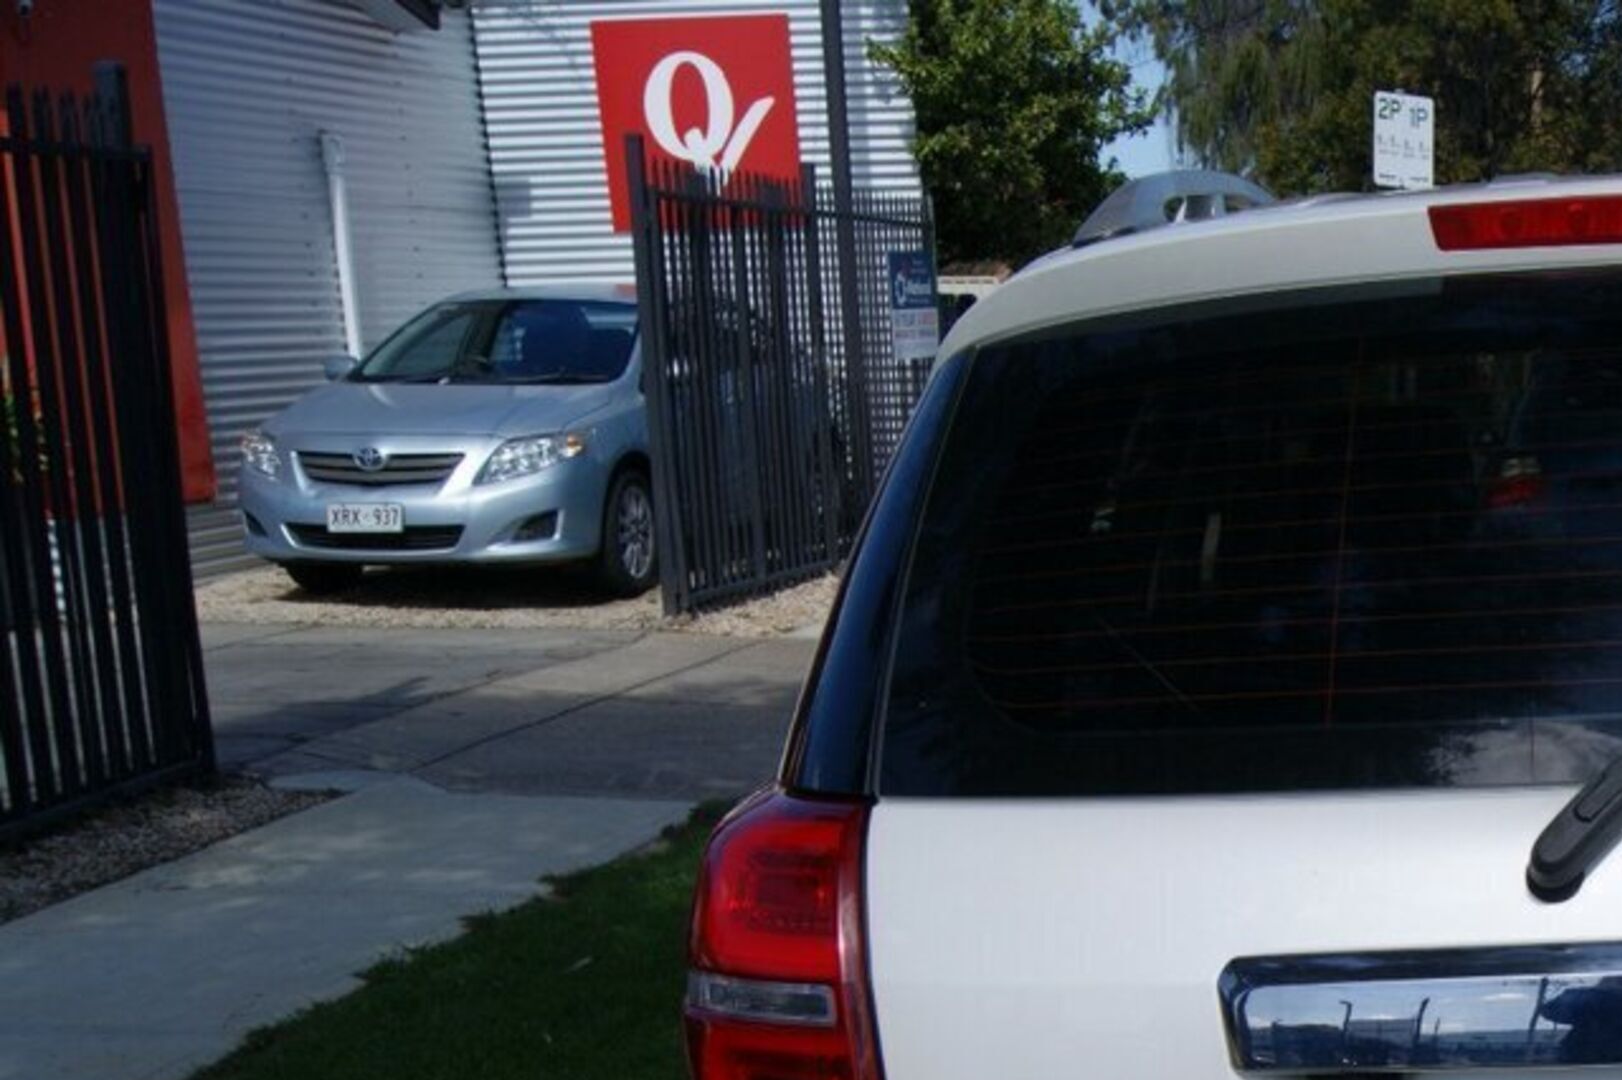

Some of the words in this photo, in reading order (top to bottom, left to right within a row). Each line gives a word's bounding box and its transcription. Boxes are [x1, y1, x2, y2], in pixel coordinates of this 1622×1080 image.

[1378, 98, 1402, 120] 2P
[1409, 107, 1428, 128] 1P
[373, 507, 399, 526] 937
